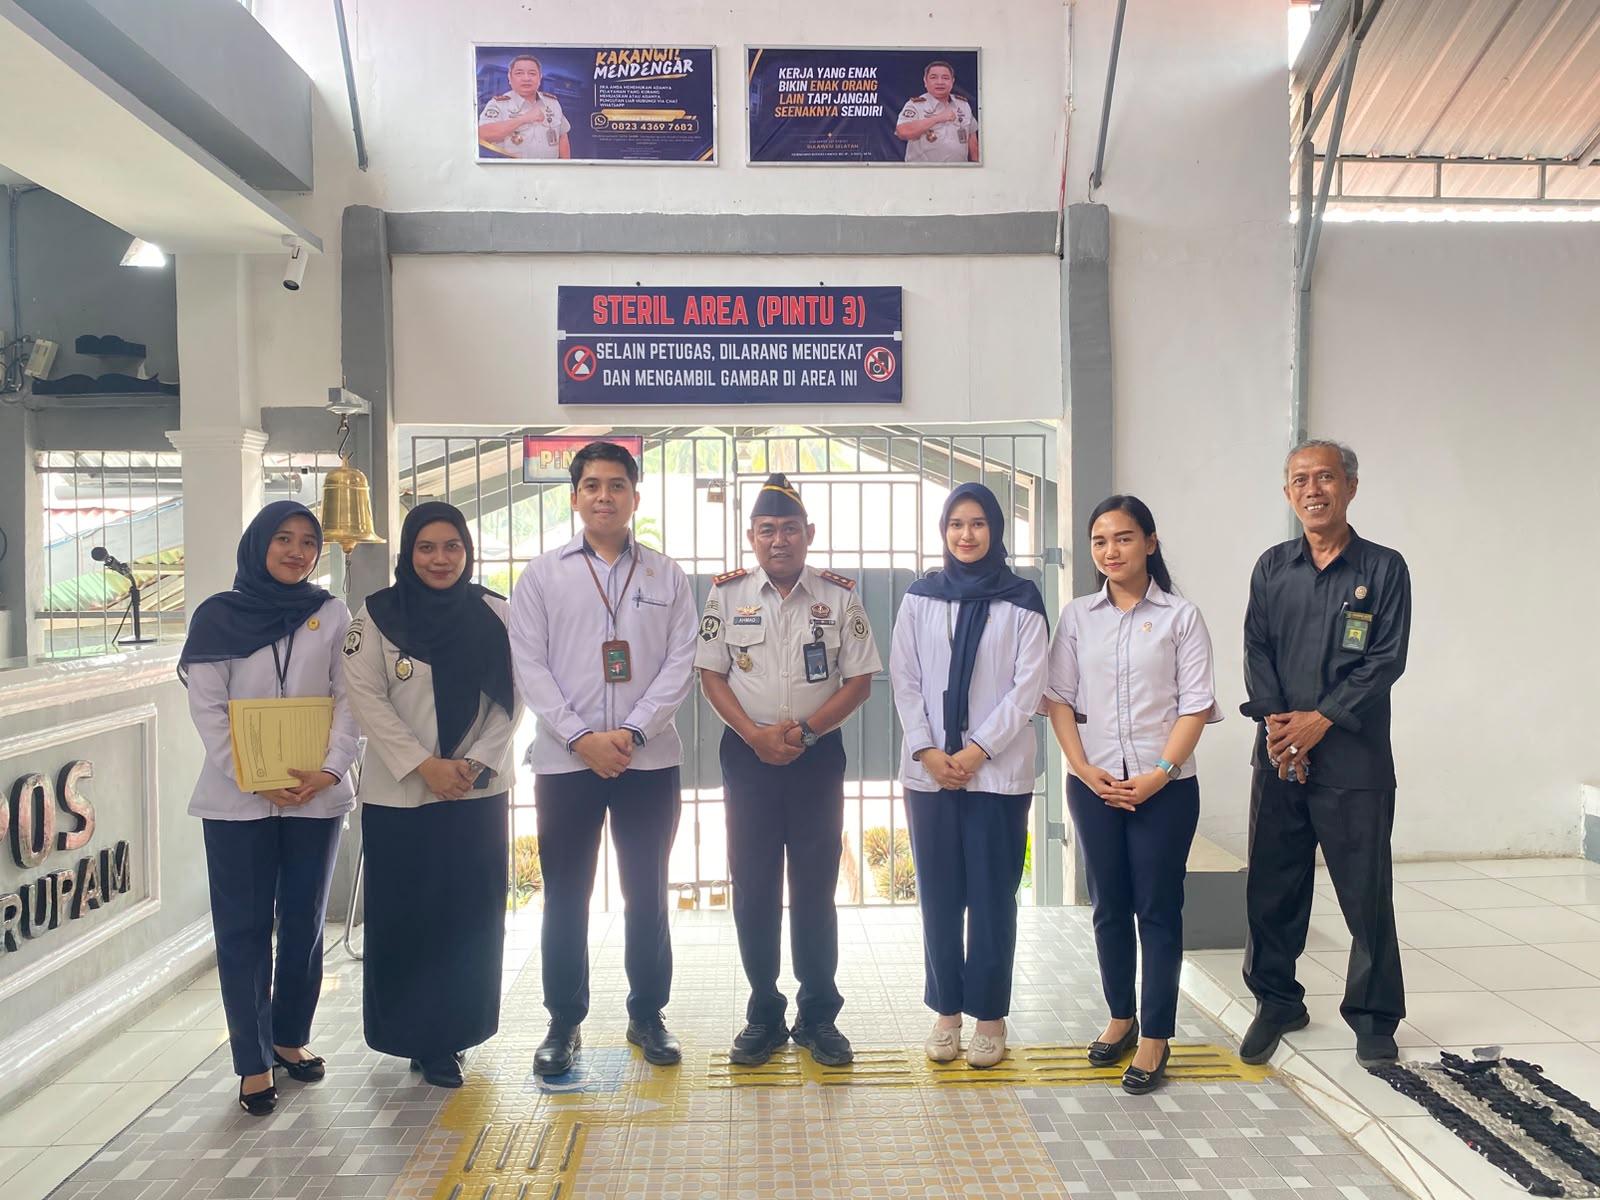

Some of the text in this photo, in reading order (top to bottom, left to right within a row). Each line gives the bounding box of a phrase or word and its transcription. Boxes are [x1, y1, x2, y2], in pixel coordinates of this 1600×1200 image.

[596, 48, 681, 65] KAKANWIL
[594, 59, 693, 80] MENDENGAR
[779, 67, 877, 78] KERJA YANG ENAK
[779, 80, 878, 91] BIKIN ENAK ORANG
[780, 93, 877, 104] LAIN TAPI JANGAN
[774, 106, 883, 117] SEENAKNYA SENDIRI
[612, 122, 638, 130] 0823
[592, 295, 866, 328] STERIL AREA (PINTU 3)
[596, 342, 864, 362] SELAIN PETUGAS, DILARANG MENDEKAT
[603, 370, 858, 386] DAN MENGAMBIL GAMBAR DI AREA INI
